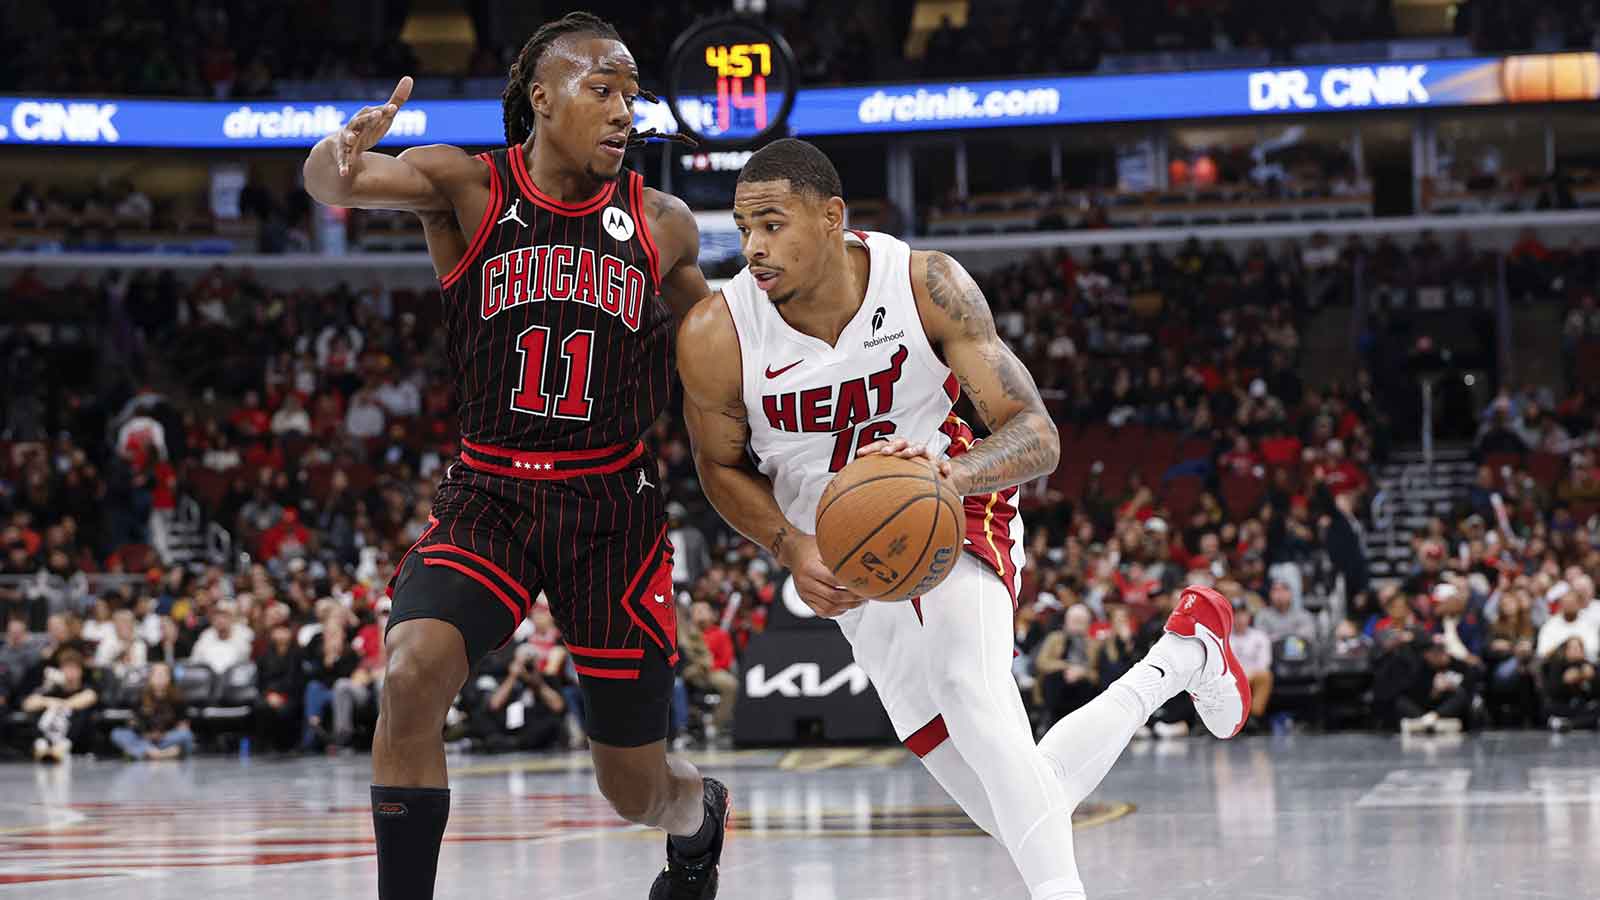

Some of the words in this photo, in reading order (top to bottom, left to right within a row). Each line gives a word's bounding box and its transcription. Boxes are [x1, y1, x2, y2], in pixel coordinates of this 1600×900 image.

[717, 75, 767, 131] 14
[858, 86, 1060, 123] drcinik.com
[1249, 70, 1317, 111] DR.
[481, 245, 645, 332] CHICAGO
[863, 329, 905, 349] Robinhood
[510, 325, 595, 421] 11
[762, 344, 909, 433] HEAT
[745, 662, 869, 698] KIA
